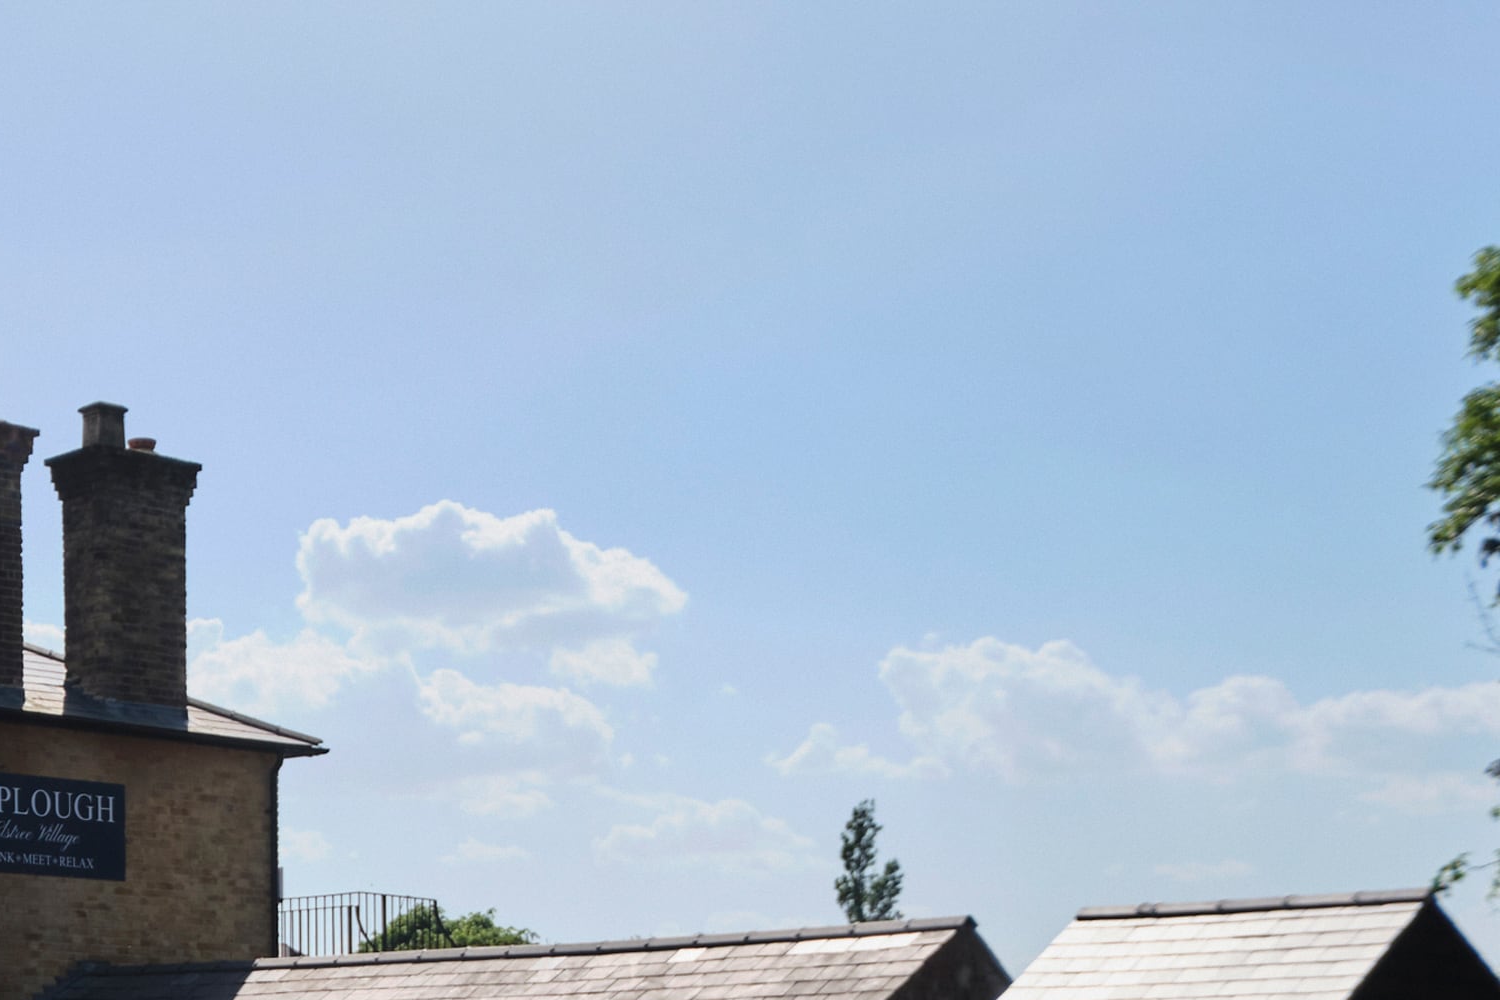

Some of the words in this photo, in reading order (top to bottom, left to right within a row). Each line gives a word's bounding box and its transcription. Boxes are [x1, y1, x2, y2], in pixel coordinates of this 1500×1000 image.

[38, 823, 80, 852] Village
[22, 853, 52, 865] MEET
[60, 856, 94, 869] RELAX
